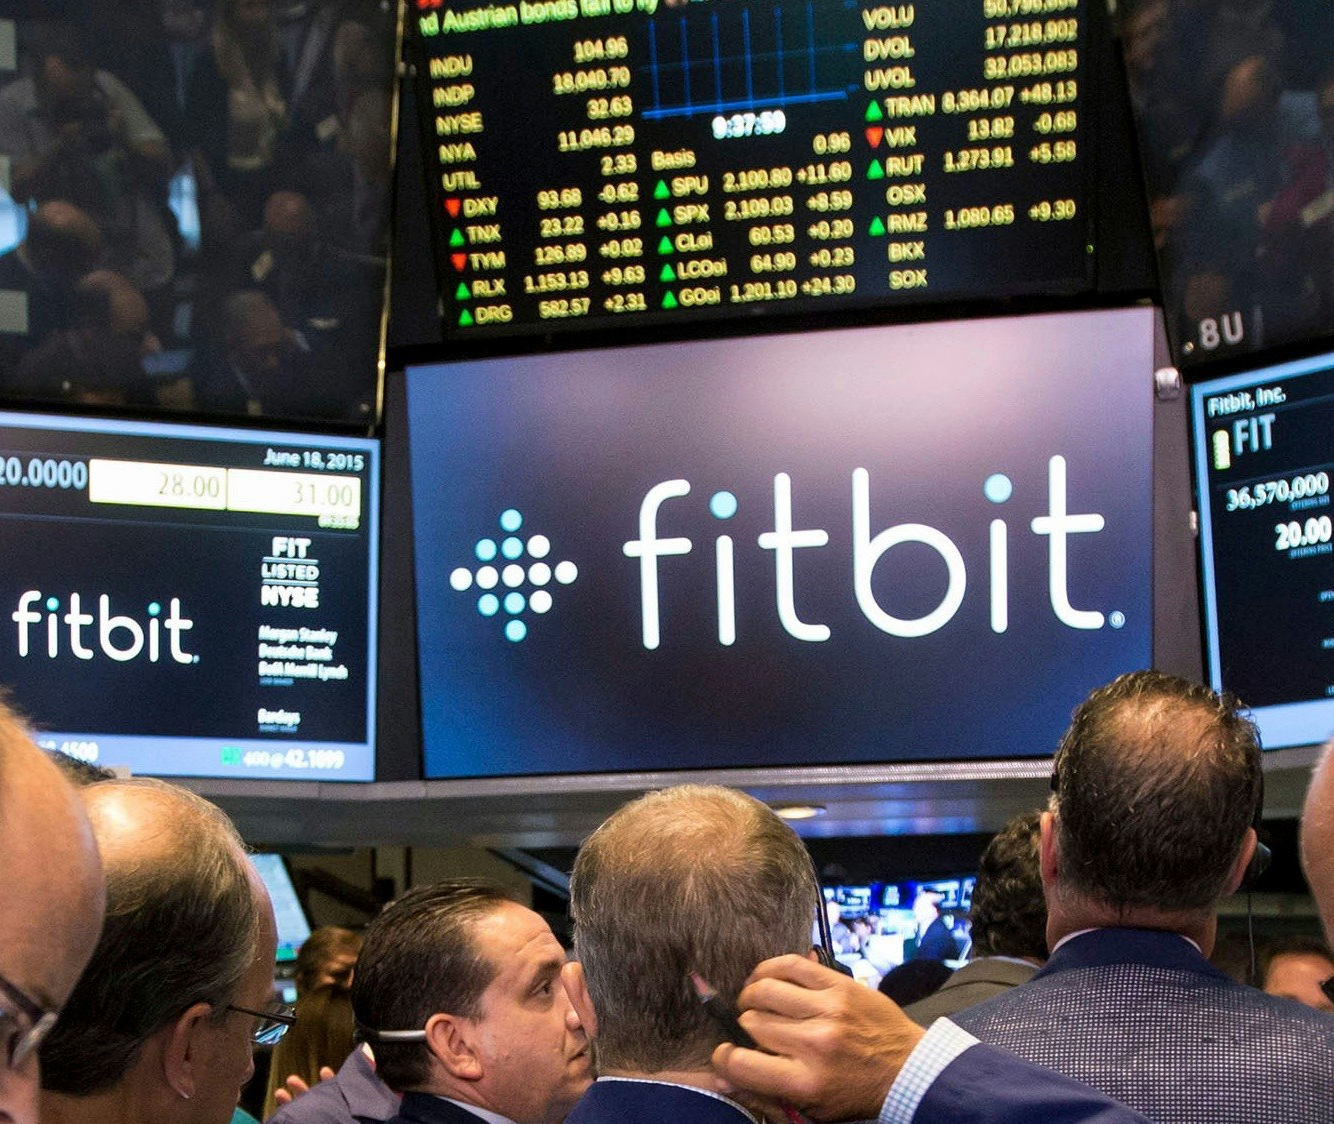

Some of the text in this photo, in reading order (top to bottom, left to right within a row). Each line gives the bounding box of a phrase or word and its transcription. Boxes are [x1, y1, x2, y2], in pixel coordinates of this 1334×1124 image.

[443, 6, 519, 34] Austrian
[519, 0, 579, 24] bonds
[862, 4, 915, 31] VOLU
[573, 36, 629, 63] 104.96
[863, 36, 916, 62] DVOL
[429, 54, 473, 79] INDU
[864, 66, 916, 92] UVOL
[553, 66, 631, 95] 18,040.70
[432, 84, 475, 108] INDP
[587, 95, 633, 120] 32.63
[884, 94, 936, 119] TRAN
[435, 111, 484, 136] NYSE
[885, 125, 917, 148] VIX
[438, 142, 477, 164] NYA
[651, 131, 851, 171] Basis 0.96
[600, 154, 637, 176] 2.33
[671, 160, 852, 197] SPU 2,100.80 +11.60
[885, 154, 925, 178] RUT
[442, 171, 482, 192] UTIL
[886, 183, 926, 206] OSX
[462, 196, 498, 218] DXY
[598, 182, 639, 204] -0.62
[673, 203, 710, 225] SPX
[724, 195, 794, 221] 2,109.03
[466, 209, 641, 245] TNX 23.22 +0.16
[887, 199, 1076, 234] RMZ 1,080.65 +9.30
[748, 224, 795, 246] 60.53
[807, 218, 854, 240] +0.20
[469, 251, 506, 271] TYM
[598, 238, 643, 259] +0.02
[809, 246, 855, 268] +0.23
[888, 240, 925, 263] BKX
[471, 265, 646, 298] RLX 1,153.13 +9.63
[730, 279, 797, 303] 1,201.10
[888, 269, 928, 290] SOX
[475, 293, 647, 324] DRG 582.57 +2.31
[1198, 311, 1244, 350] 8U
[1207, 386, 1287, 418] Fitbit, Inc.
[1233, 413, 1276, 456] FIT
[263, 448, 301, 468] June
[302, 451, 325, 470] 18,
[325, 453, 364, 472] 2015
[158, 473, 220, 498] 28.00
[294, 481, 354, 507] 31.00
[1226, 471, 1330, 512] 36,570,000
[1274, 515, 1332, 551] 20.00
[271, 536, 311, 559] FIT
[622, 455, 1106, 650] fitbit
[261, 563, 320, 581] LISTED
[260, 584, 319, 609] NYSE
[12, 590, 194, 664] fitbit
